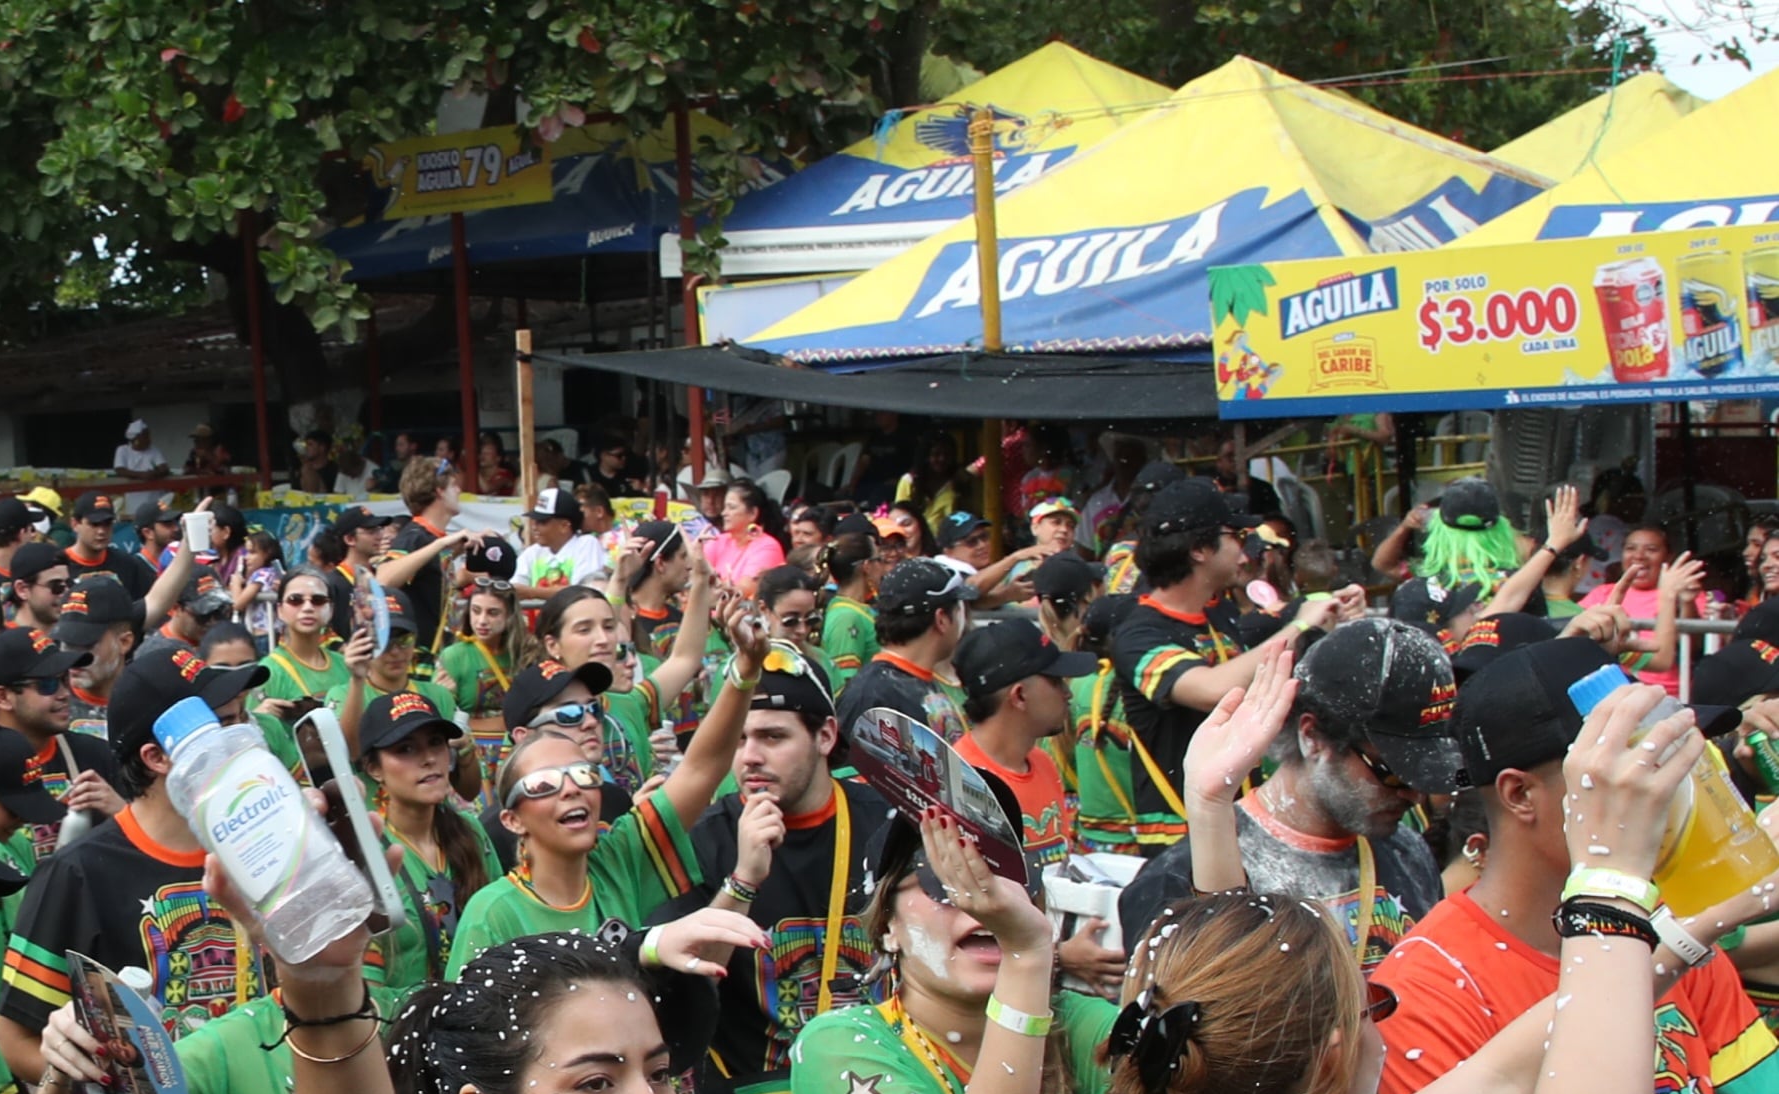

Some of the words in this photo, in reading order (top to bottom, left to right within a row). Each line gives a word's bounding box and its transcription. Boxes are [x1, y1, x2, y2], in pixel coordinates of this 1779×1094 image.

[417, 148, 460, 171] KIOSKO
[463, 144, 503, 187] 79
[417, 168, 463, 192] AGUILA
[915, 201, 1228, 318] AGUILA
[1285, 271, 1392, 336] AGUILA
[1425, 281, 1450, 293] POR
[1455, 276, 1487, 291] SOLO
[1419, 287, 1577, 352] $3.000
[1320, 357, 1372, 374] CARIBE
[1522, 341, 1550, 352] CADA
[1553, 339, 1577, 350] UNA
[212, 785, 292, 843] Electrolit
